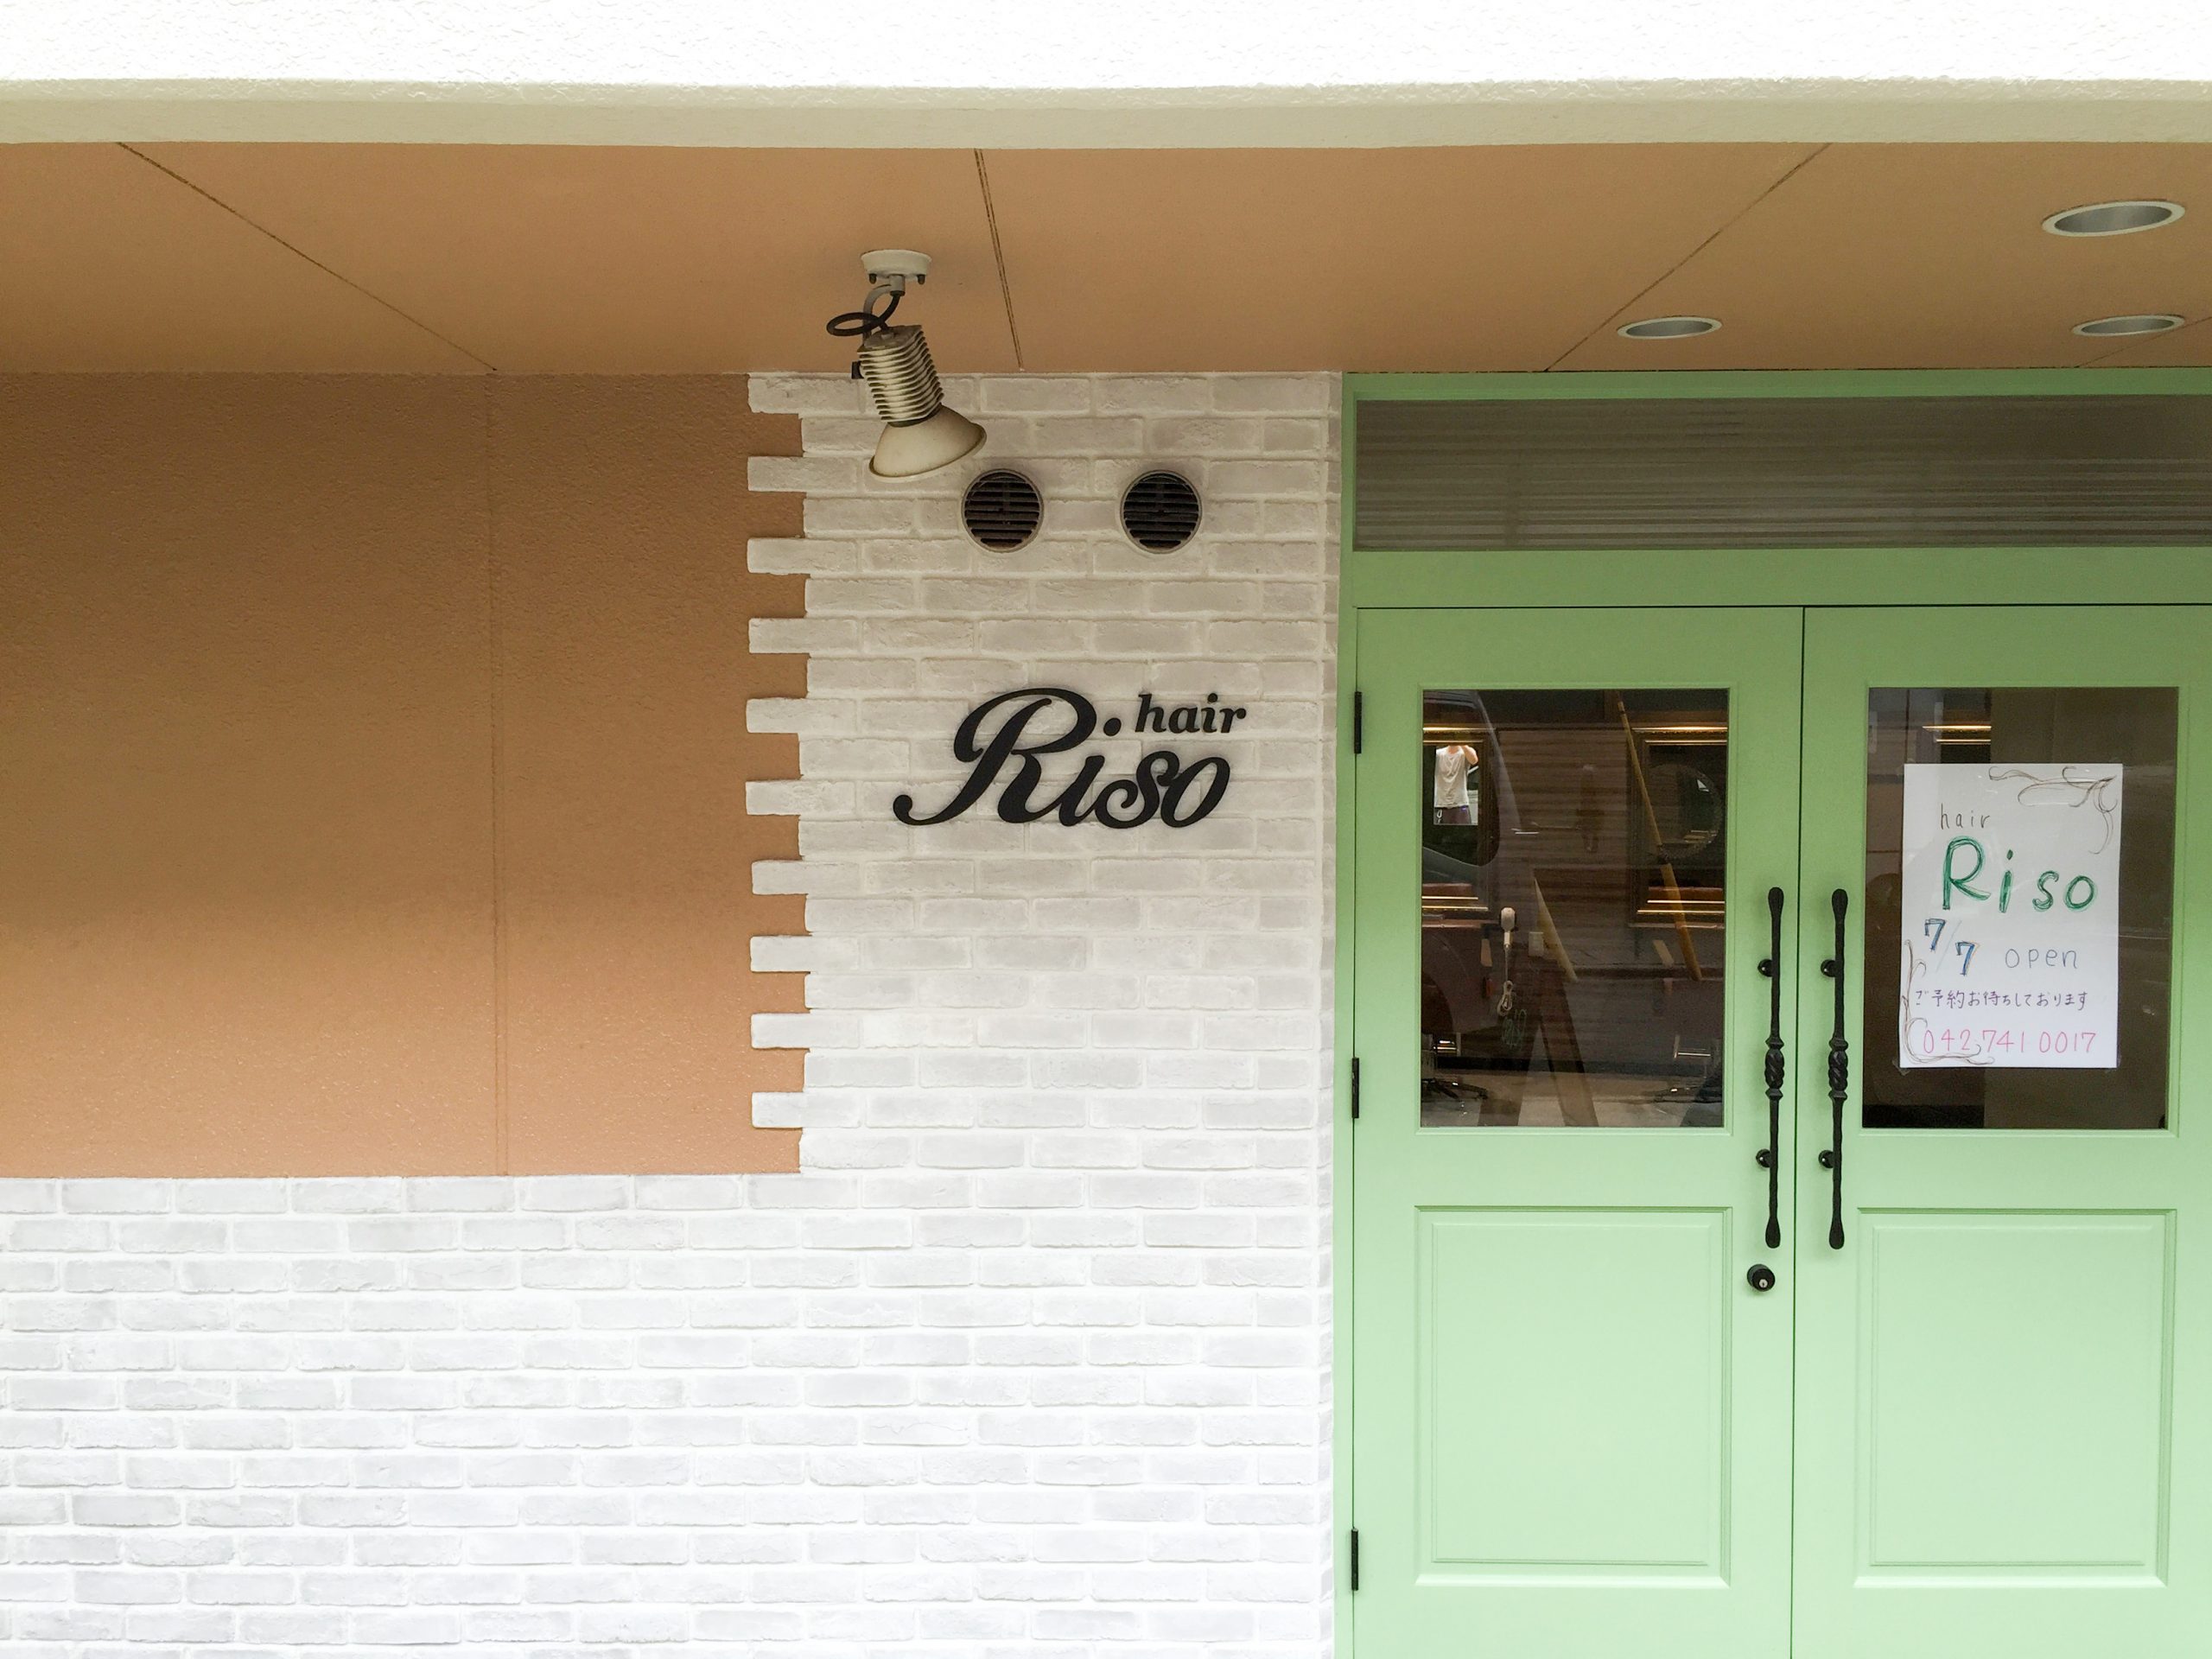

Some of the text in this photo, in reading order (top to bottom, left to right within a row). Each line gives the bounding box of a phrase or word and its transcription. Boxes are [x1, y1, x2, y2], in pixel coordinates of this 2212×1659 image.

[1135, 693, 1247, 734] hair
[893, 688, 1231, 830] Riso
[1940, 803, 1991, 830] hair
[1942, 835, 2097, 914] Riso
[2005, 948, 2078, 969] open
[1915, 988, 2089, 1012] ご予約お待ちしております
